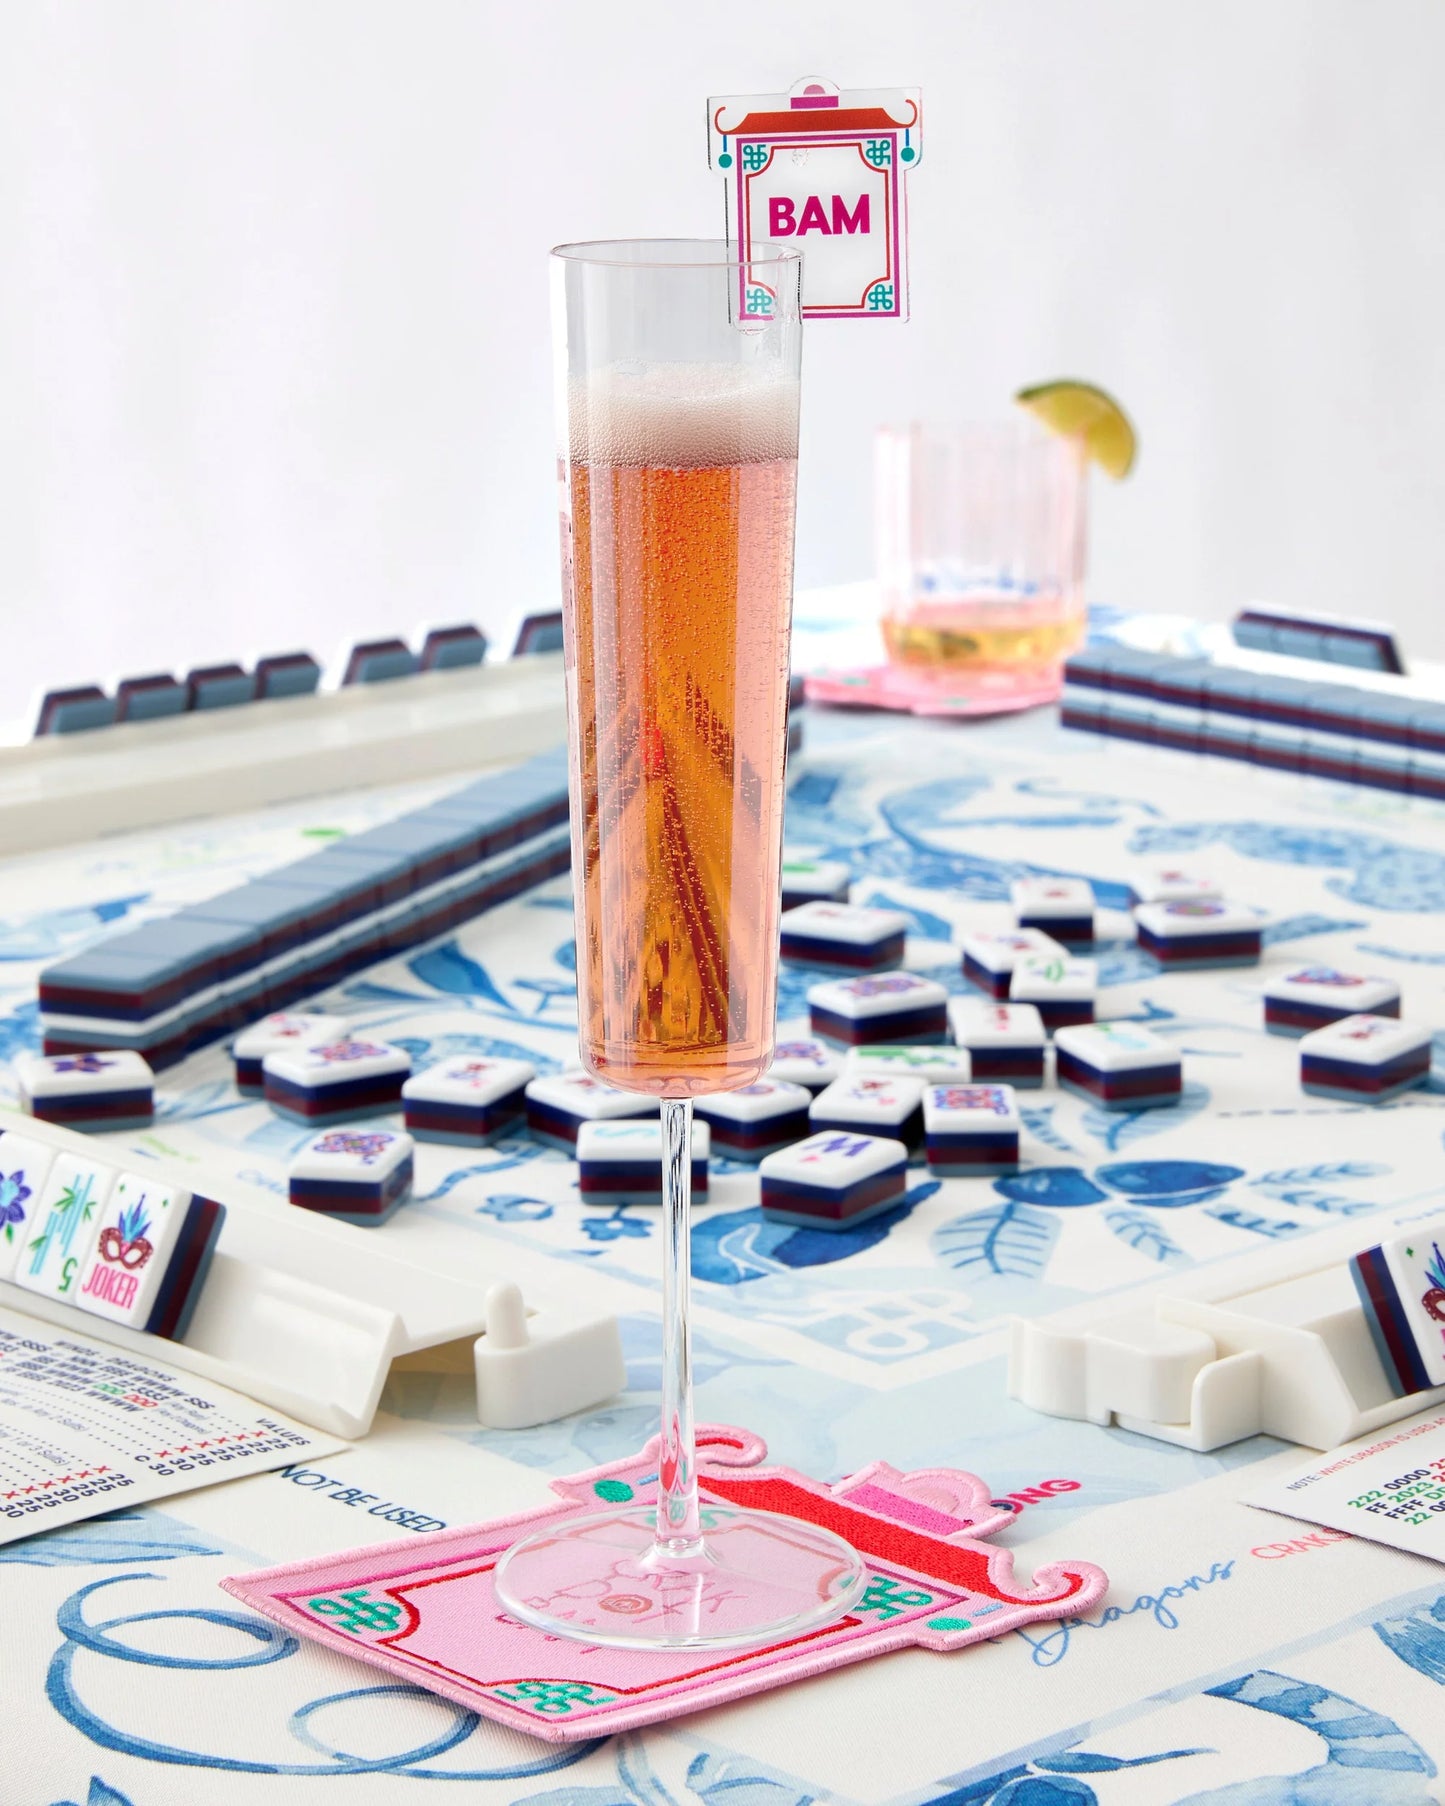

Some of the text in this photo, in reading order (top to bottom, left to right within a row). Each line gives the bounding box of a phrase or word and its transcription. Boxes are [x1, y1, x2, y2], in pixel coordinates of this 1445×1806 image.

[768, 194, 871, 237] BAM
[58, 1257, 79, 1293] 5
[82, 1263, 139, 1310] JOKER
[122, 1394, 159, 1408] DDD
[227, 1444, 254, 1458] 25
[255, 1418, 312, 1446] VALUES
[246, 1441, 273, 1454] 25
[264, 1438, 291, 1450] 25
[189, 1453, 217, 1466] 25
[208, 1449, 237, 1462] 25
[1286, 1472, 1322, 1491] NOTE:
[1319, 1456, 1358, 1477] WHITE
[1350, 1439, 1399, 1462] DRAGON
[1405, 1423, 1437, 1437] USED
[134, 1455, 151, 1463] C
[148, 1463, 175, 1476] 30
[169, 1458, 195, 1471] 30
[89, 1478, 117, 1492] 25
[107, 1473, 135, 1487] 25
[53, 1488, 80, 1502] 30
[71, 1483, 99, 1497] 25
[34, 1493, 62, 1507] 25
[266, 1464, 447, 1533] NOT BE USED
[1347, 1490, 1386, 1508] 222
[1365, 1502, 1388, 1514] FF
[1387, 1482, 1434, 1503] 2023
[15, 1499, 44, 1513] 25
[1383, 1499, 1424, 1519] FFFF
[1403, 1512, 1433, 1525] 22
